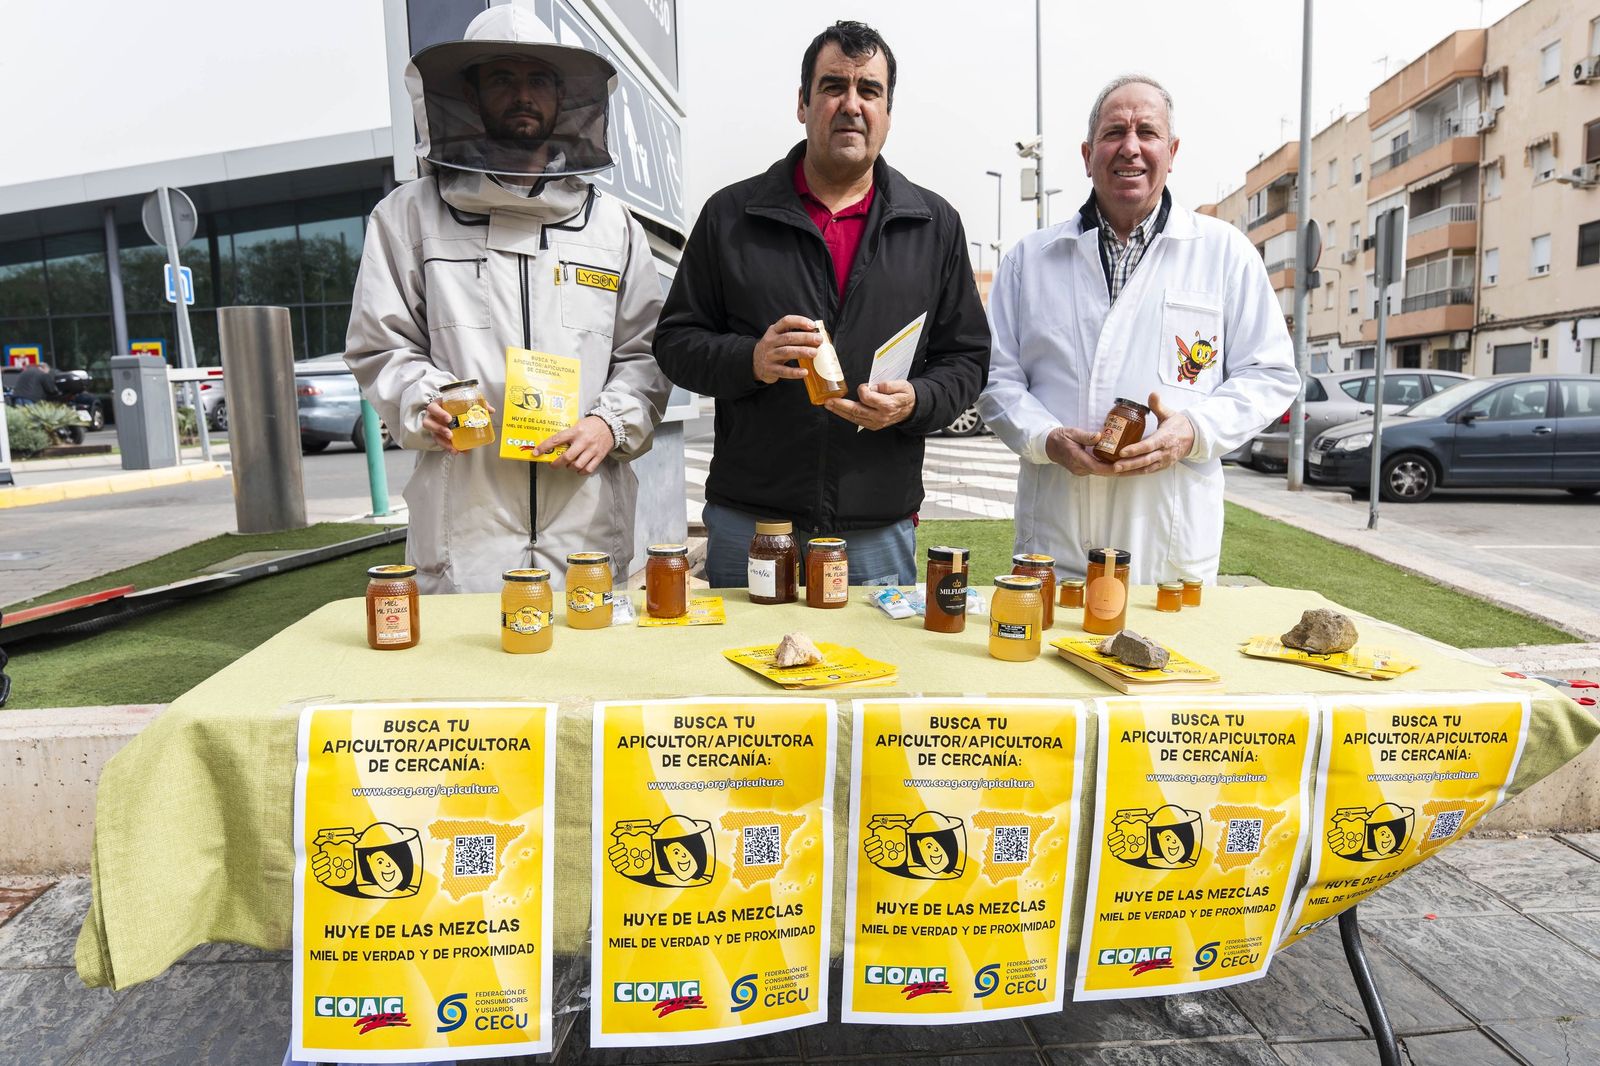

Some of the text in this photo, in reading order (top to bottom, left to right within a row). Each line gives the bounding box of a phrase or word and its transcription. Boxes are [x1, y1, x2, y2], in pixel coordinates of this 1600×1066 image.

[578, 271, 618, 289] LYSON
[384, 719, 469, 733] BUSCA TU
[674, 716, 755, 729] BUSCA TU
[930, 716, 1007, 730] BUSCA TU
[1172, 713, 1244, 726] BUSCA TU
[1392, 715, 1461, 728] BUSCA TU
[322, 737, 531, 754] APICULTOR/APICULTORA
[617, 734, 814, 749] APICULTOR/APICULTORA
[875, 734, 1063, 749] APICULTOR/APICULTORA
[1120, 730, 1296, 746] APICULTOR/APICULTORA
[1343, 732, 1508, 745] APICULTOR/APICULTORA
[662, 749, 771, 767] DE CERCANÍA:
[918, 750, 1022, 766] DE CERCANÍA:
[1160, 746, 1258, 762] DE CERCANÍA:
[1380, 745, 1471, 762] DE CERCANÍA:
[368, 754, 484, 773] DE CERCANÍA:
[647, 778, 784, 792] www.coag.org/apicultura
[904, 779, 1034, 791] www.coag.org/apicultura
[1146, 774, 1266, 784] www.coag.org/apicultura
[1367, 772, 1479, 783] www.coag.org/apicultura
[352, 784, 499, 799] www.coag.org/apicultura
[1324, 878, 1361, 890] HUYE
[1361, 875, 1377, 886] DE
[1114, 886, 1270, 903] HUYE DE LAS MEZCLAS
[1308, 896, 1330, 906] MIEL
[1332, 895, 1345, 903] DE
[624, 903, 803, 926] HUYE DE LAS MEZCLAS
[876, 900, 1046, 916] HUYE DE LAS MEZCLAS
[1100, 904, 1276, 922] MIEL DE VERDAD Y DE PROXIMIDAD
[324, 918, 520, 939] HUYE DE LAS MEZCLAS
[862, 920, 1056, 936] MIEL DE VERDAD Y DE PROXIMIDAD
[609, 925, 816, 948] MIEL DE VERDAD Y DE PROXIMIDAD
[310, 943, 534, 962] MIEL DE VERDAD Y DE PROXIMIDAD
[1100, 948, 1171, 965] COAG
[1220, 952, 1259, 968] CECU
[1006, 964, 1048, 974] CONSUMIDORES
[1007, 959, 1038, 967] FEDERACIÓN
[764, 967, 800, 977] FEDERACIÓN
[764, 973, 809, 985] CONSUMIDORES
[866, 966, 946, 984] COAG
[476, 989, 516, 998] FEDERACIÓN
[615, 983, 699, 1002] COAG
[769, 982, 797, 990] USUARIOS
[1005, 978, 1047, 995] CECU
[476, 996, 528, 1005] CONSUMIDORES
[764, 986, 808, 1007] CECU
[316, 997, 403, 1017] COAG
[475, 1013, 528, 1031] CECU
